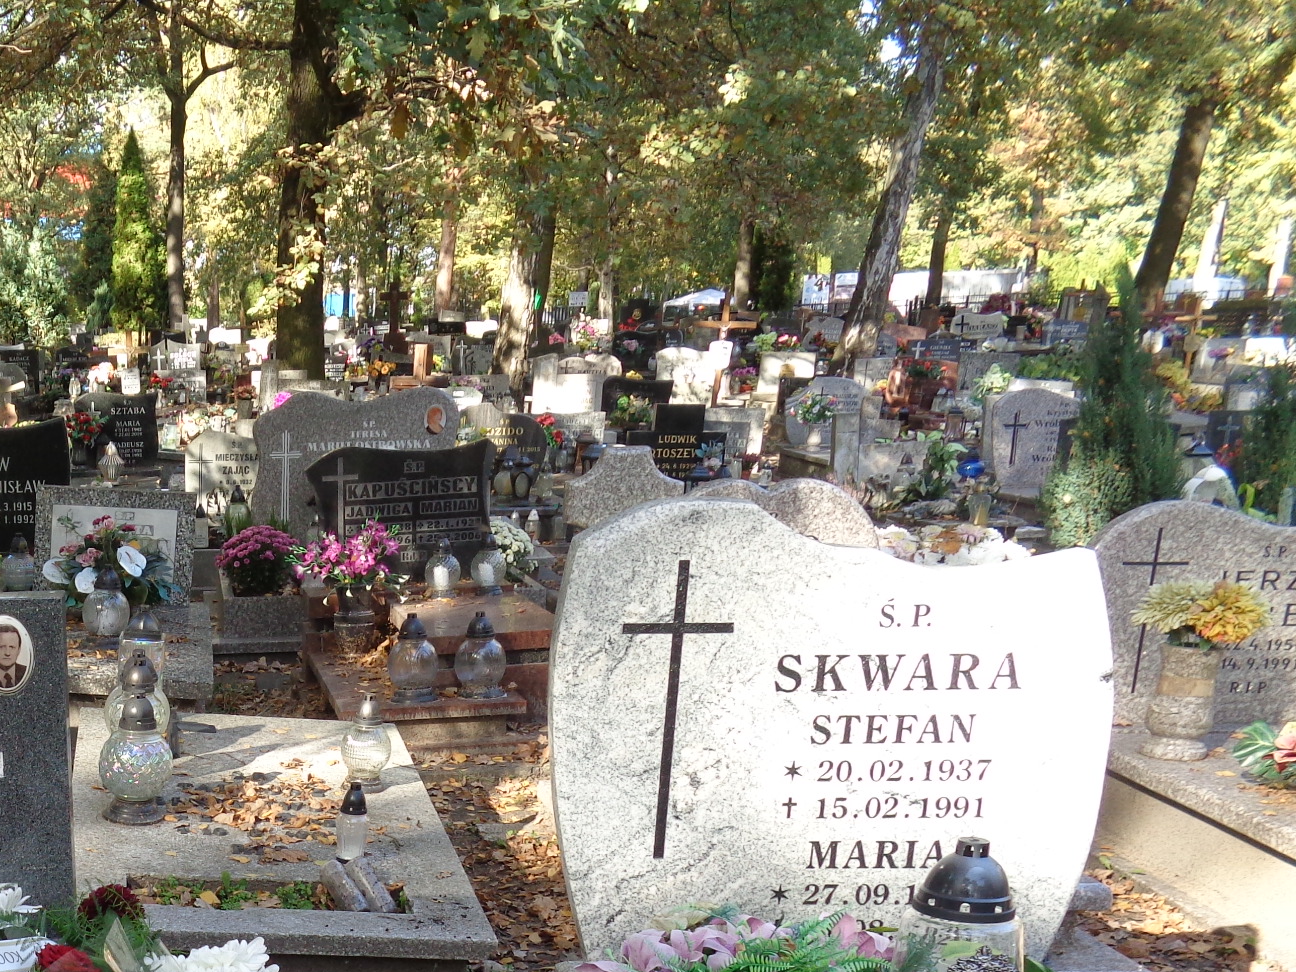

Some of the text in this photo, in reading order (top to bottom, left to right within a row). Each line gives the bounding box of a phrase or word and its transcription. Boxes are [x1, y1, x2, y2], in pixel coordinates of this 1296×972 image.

[110, 406, 146, 416] SZTABA
[350, 430, 388, 438] TERESA
[658, 434, 698, 444] LUDWIK
[222, 466, 250, 477] ZAJĄC
[347, 475, 477, 500] KAPUŚCIŃSCY
[346, 499, 478, 518] JADWIGA MARIAN
[774, 652, 1022, 693] SKWARA
[810, 714, 977, 745] STEFAN
[816, 759, 992, 782] 20.02.1937
[815, 796, 985, 819] 15.02.1991
[805, 840, 945, 869] MARIA
[803, 883, 917, 906] 27.09.1
